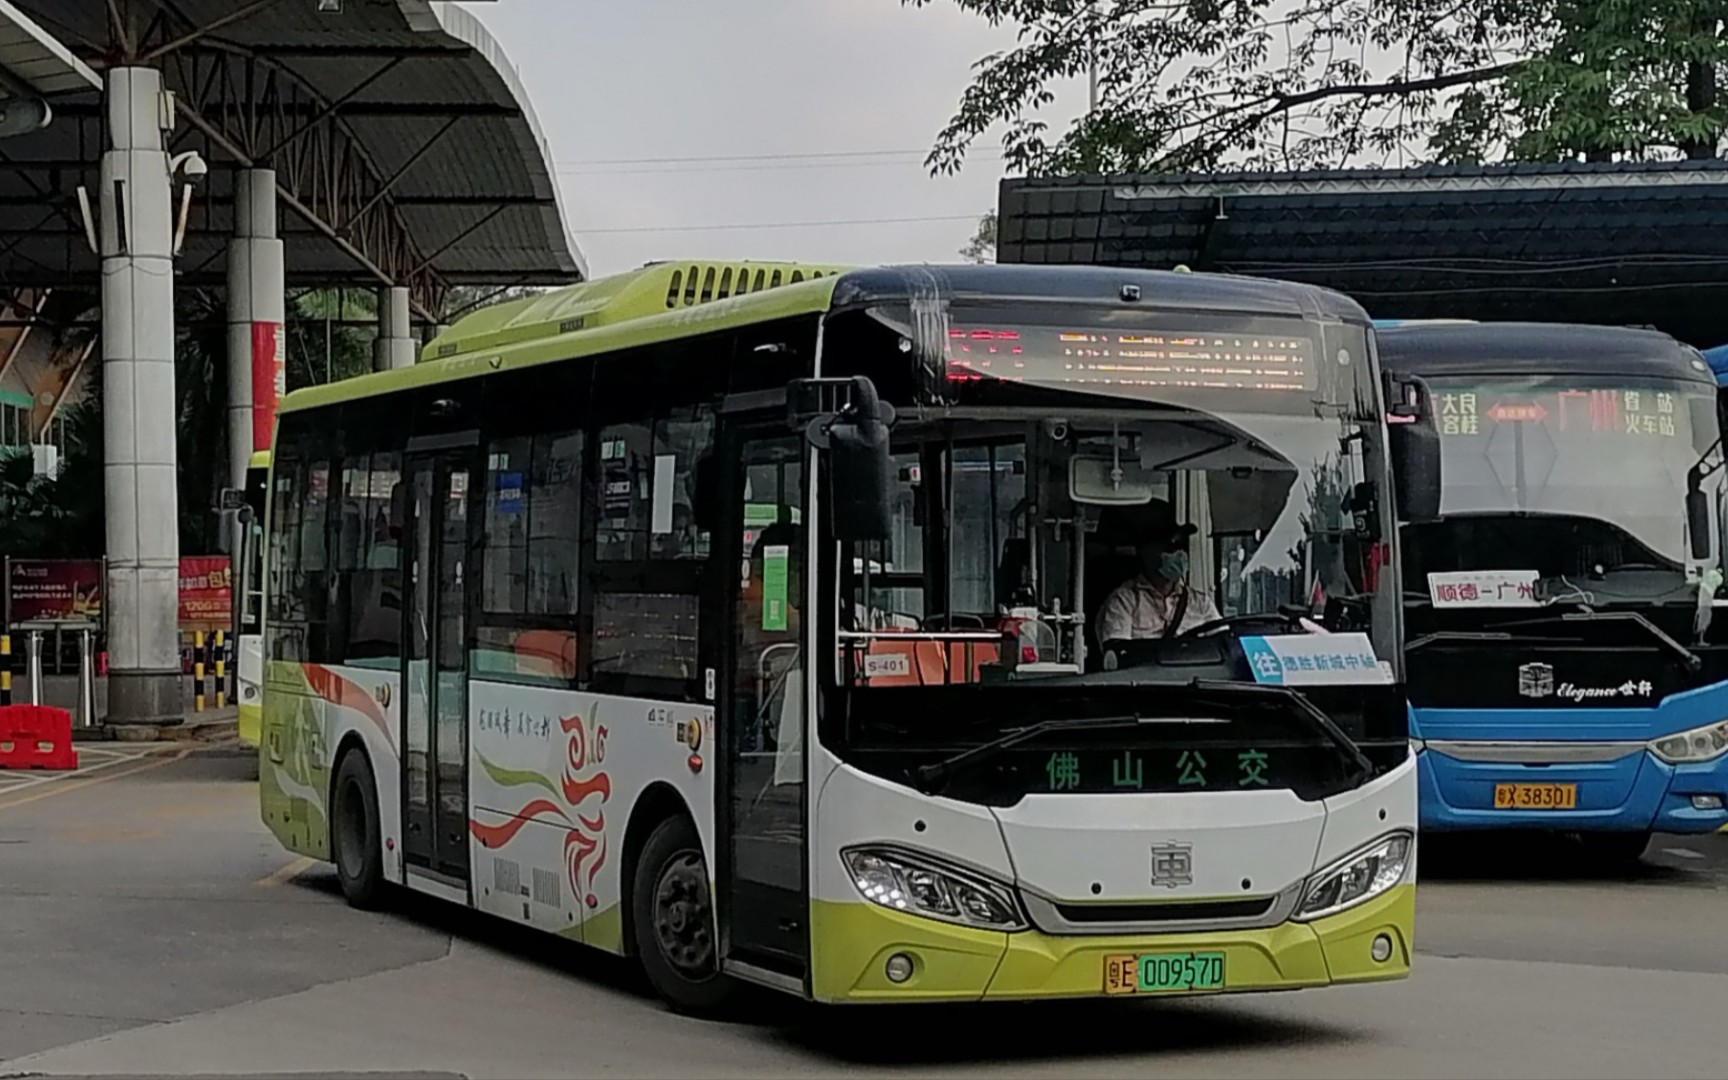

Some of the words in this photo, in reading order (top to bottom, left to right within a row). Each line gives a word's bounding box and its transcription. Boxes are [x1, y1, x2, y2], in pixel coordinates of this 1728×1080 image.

[1442, 393, 1477, 415] 大良
[1558, 389, 1618, 432] 广州
[1443, 415, 1479, 435] 容桂
[1625, 416, 1676, 436] 火车站
[868, 660, 905, 672] S-401
[1557, 682, 1618, 702] Elegance
[1046, 749, 1269, 790] 佛山公交
